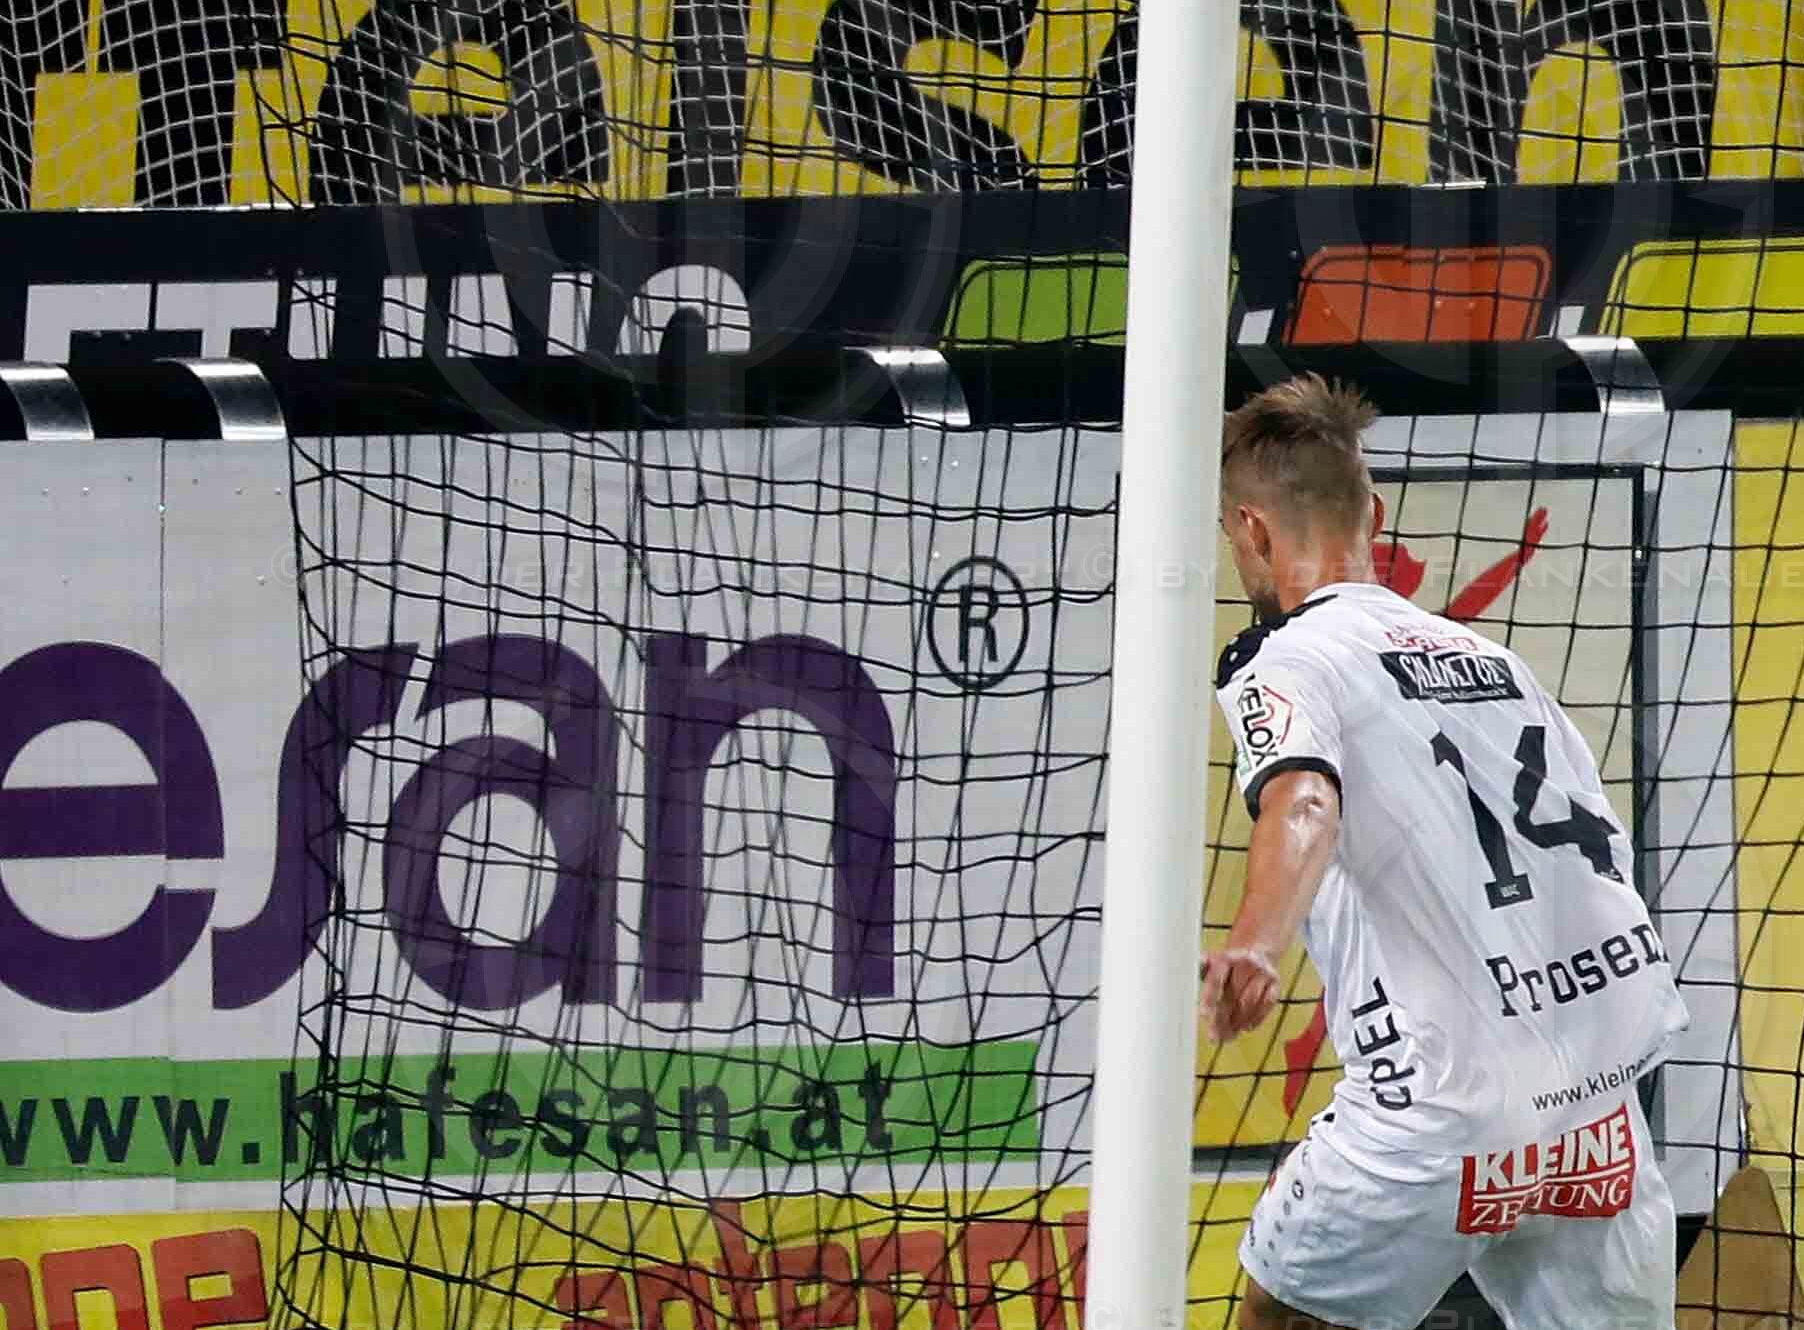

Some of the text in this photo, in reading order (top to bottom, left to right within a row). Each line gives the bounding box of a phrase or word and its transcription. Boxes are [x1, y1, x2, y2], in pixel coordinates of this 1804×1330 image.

[1430, 725, 1626, 910] 14
[1474, 1113, 1631, 1193] KLEINE
[1469, 1173, 1629, 1228] ZETUNG
